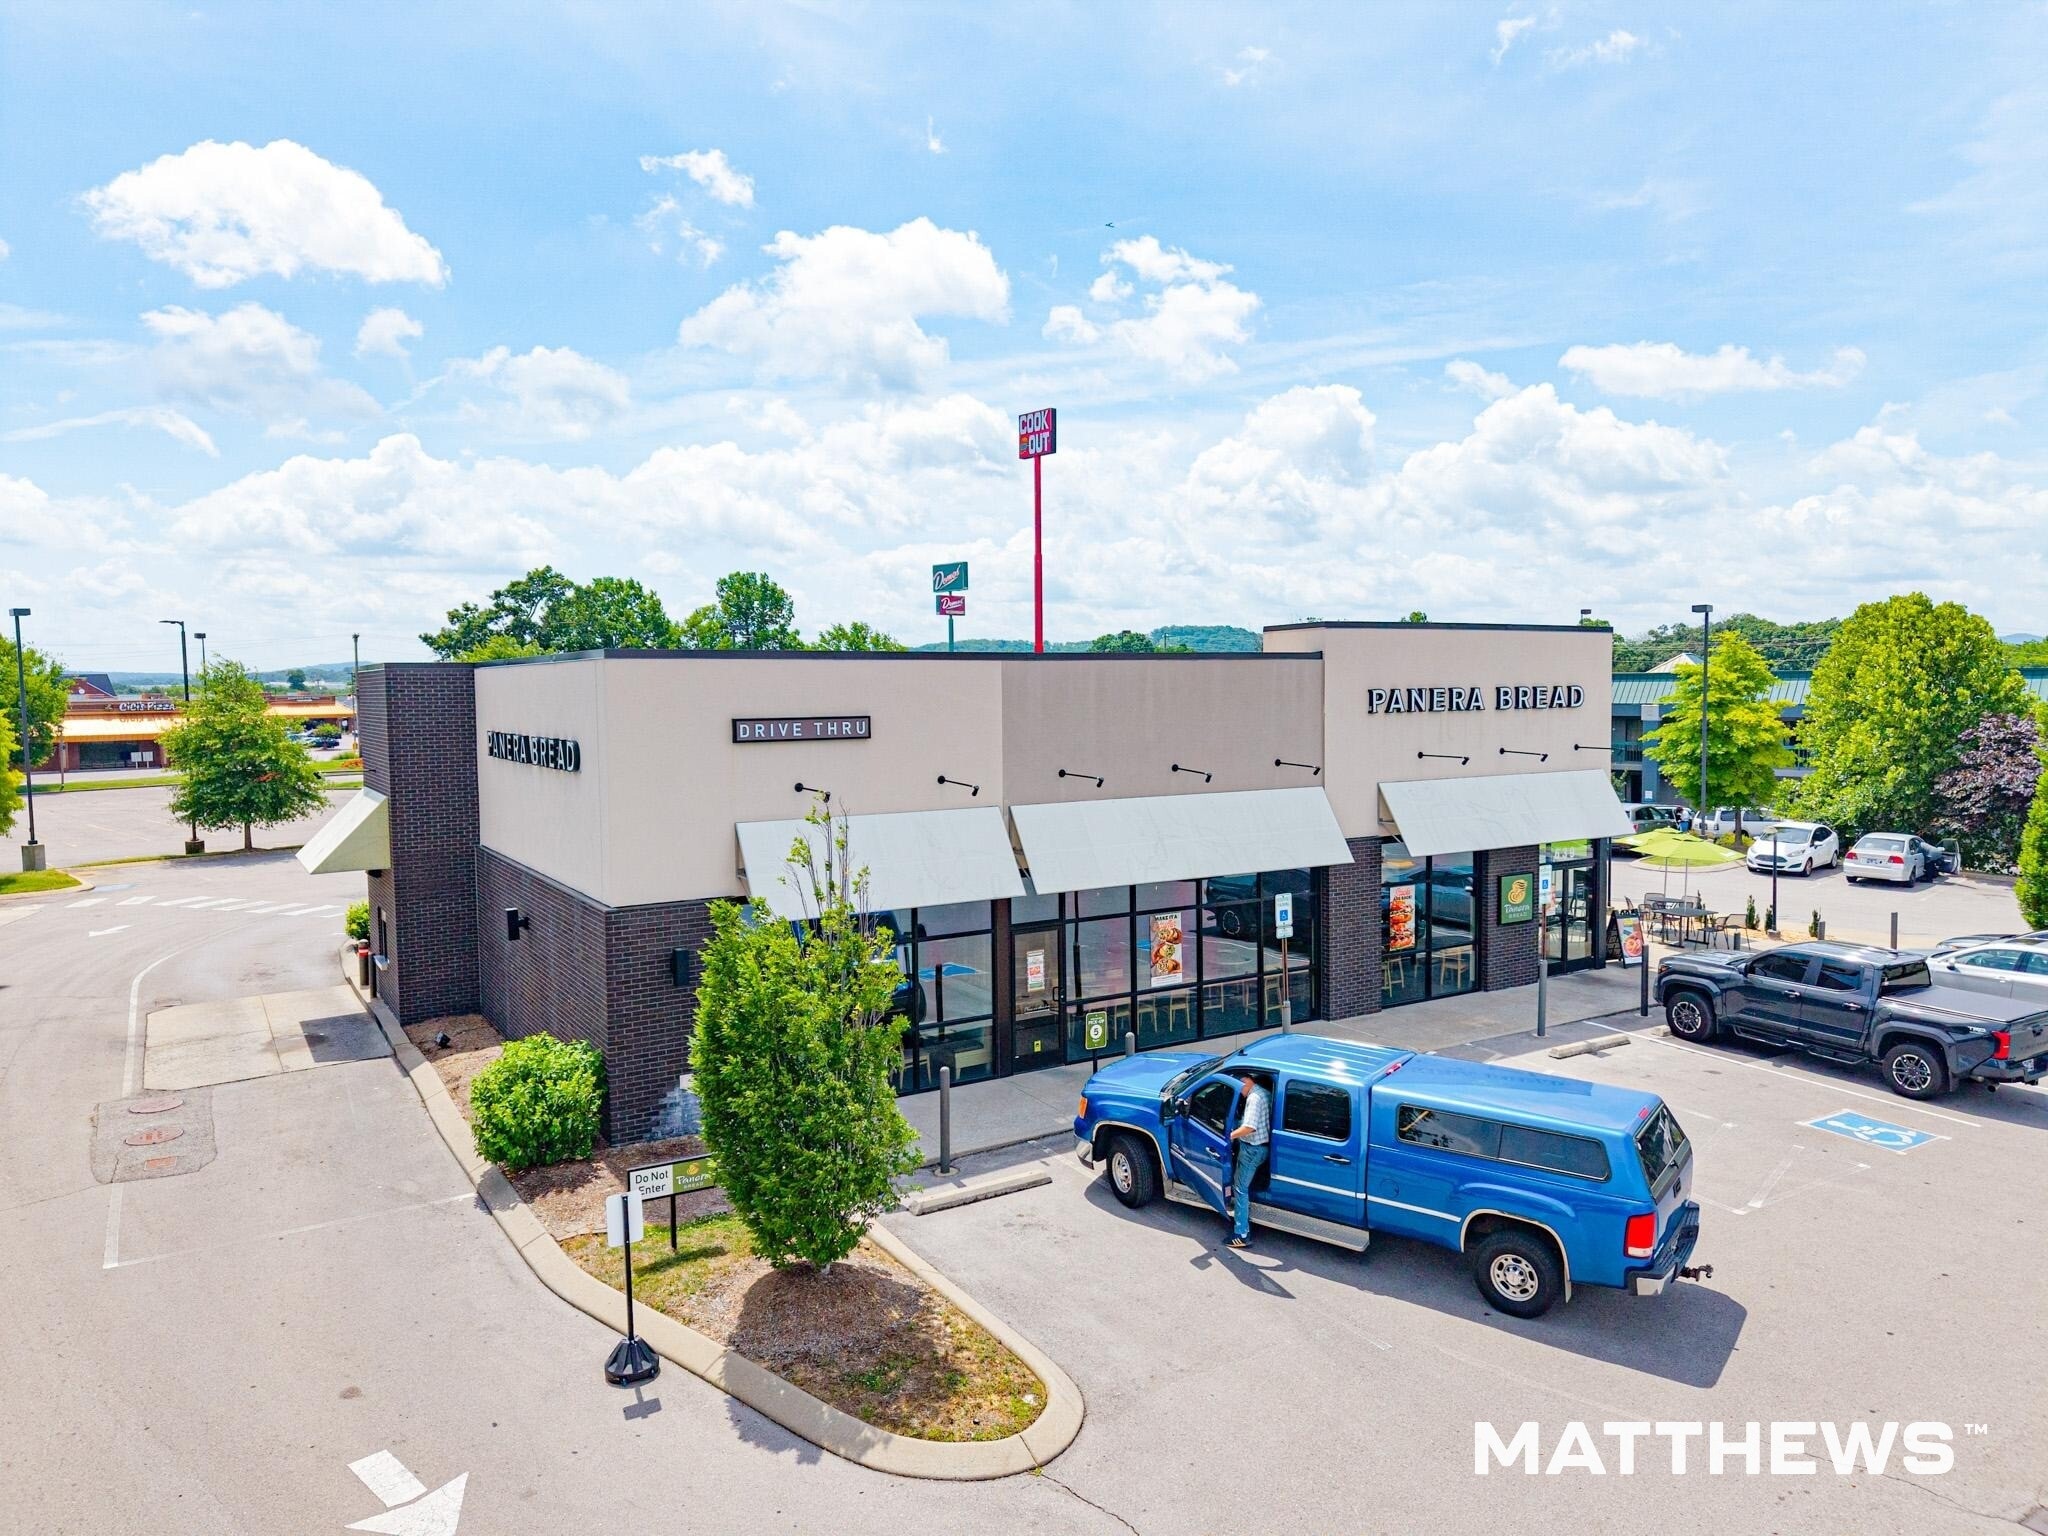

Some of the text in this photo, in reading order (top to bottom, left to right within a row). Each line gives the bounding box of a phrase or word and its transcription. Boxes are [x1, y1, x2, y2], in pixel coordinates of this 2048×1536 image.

[1020, 410, 1050, 434] COOK
[1029, 432, 1050, 454] OUT
[1368, 684, 1585, 714] PANERA BREAD
[739, 721, 867, 738] DRIVE THRU
[486, 731, 581, 773] PANERA BREAD
[1093, 1027, 1099, 1036] 5
[635, 1170, 669, 1185] Do Not
[675, 1173, 712, 1185] Panera
[638, 1183, 666, 1196] Enter
